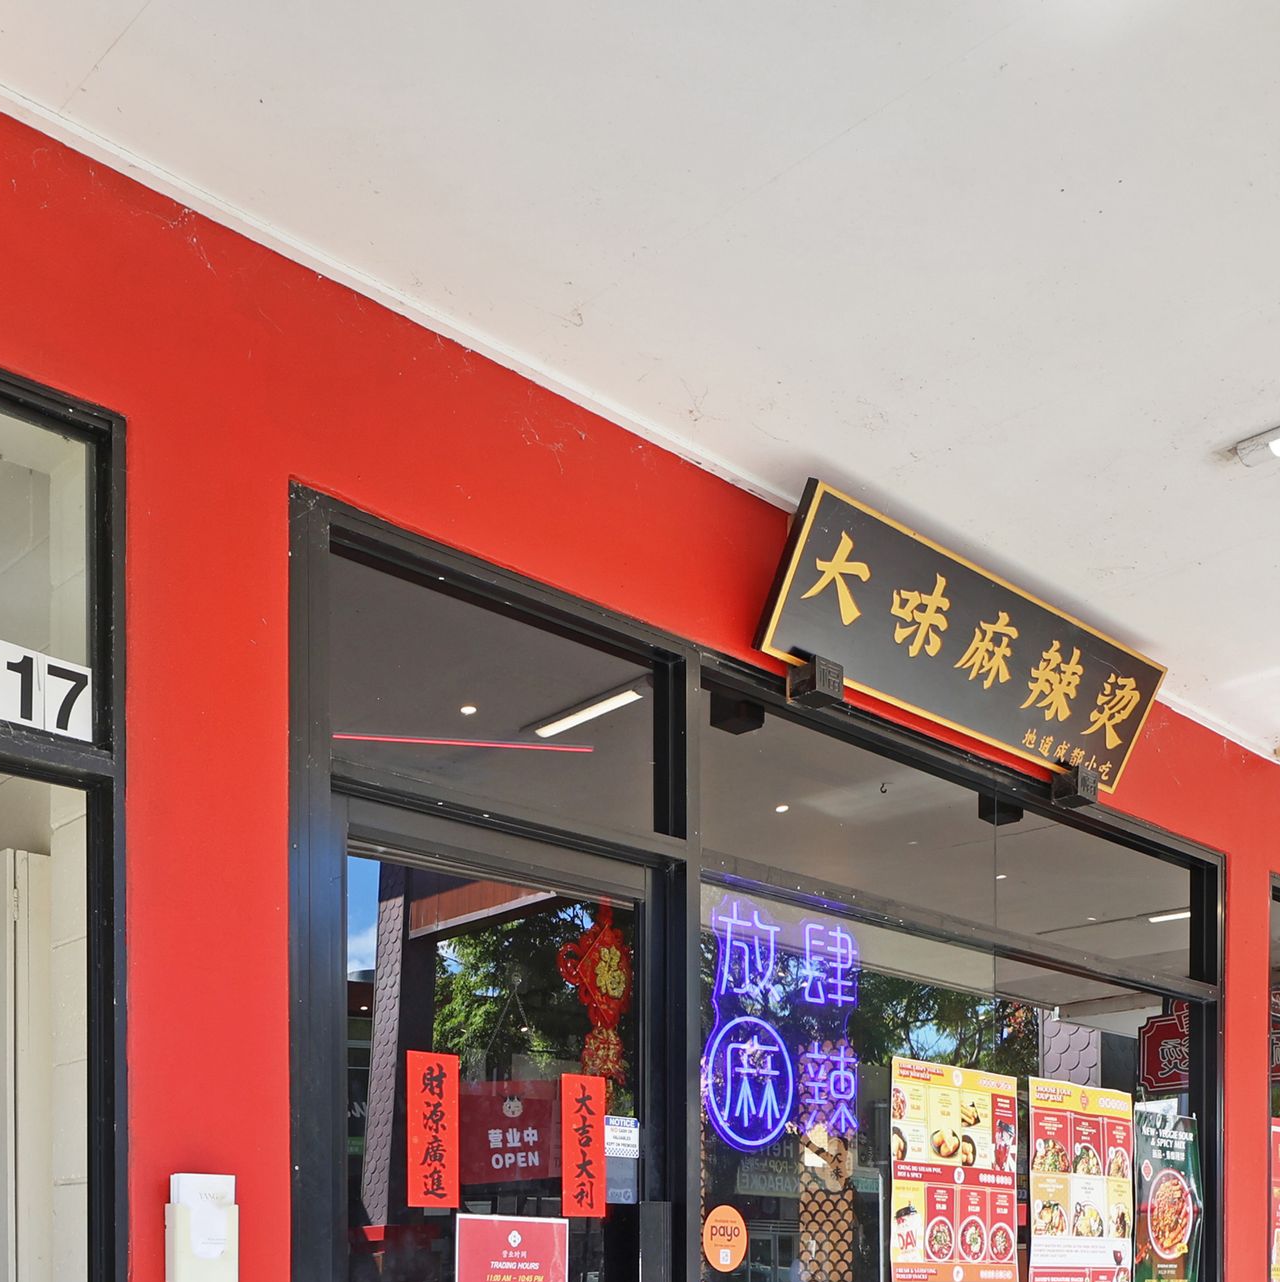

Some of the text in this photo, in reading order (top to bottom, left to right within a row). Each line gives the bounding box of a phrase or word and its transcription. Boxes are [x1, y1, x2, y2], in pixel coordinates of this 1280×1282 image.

[801, 531, 1141, 750] 大味麻辣烫
[7, 655, 88, 731] 17
[718, 903, 857, 1006] 放肆
[609, 1118, 635, 1127] NOTICE
[488, 1127, 538, 1149] 营业中
[574, 1083, 595, 1209] 大吉大利
[492, 1151, 539, 1169] OPEN
[710, 1226, 740, 1241] payo
[490, 1261, 539, 1270] TRADING HOURS
